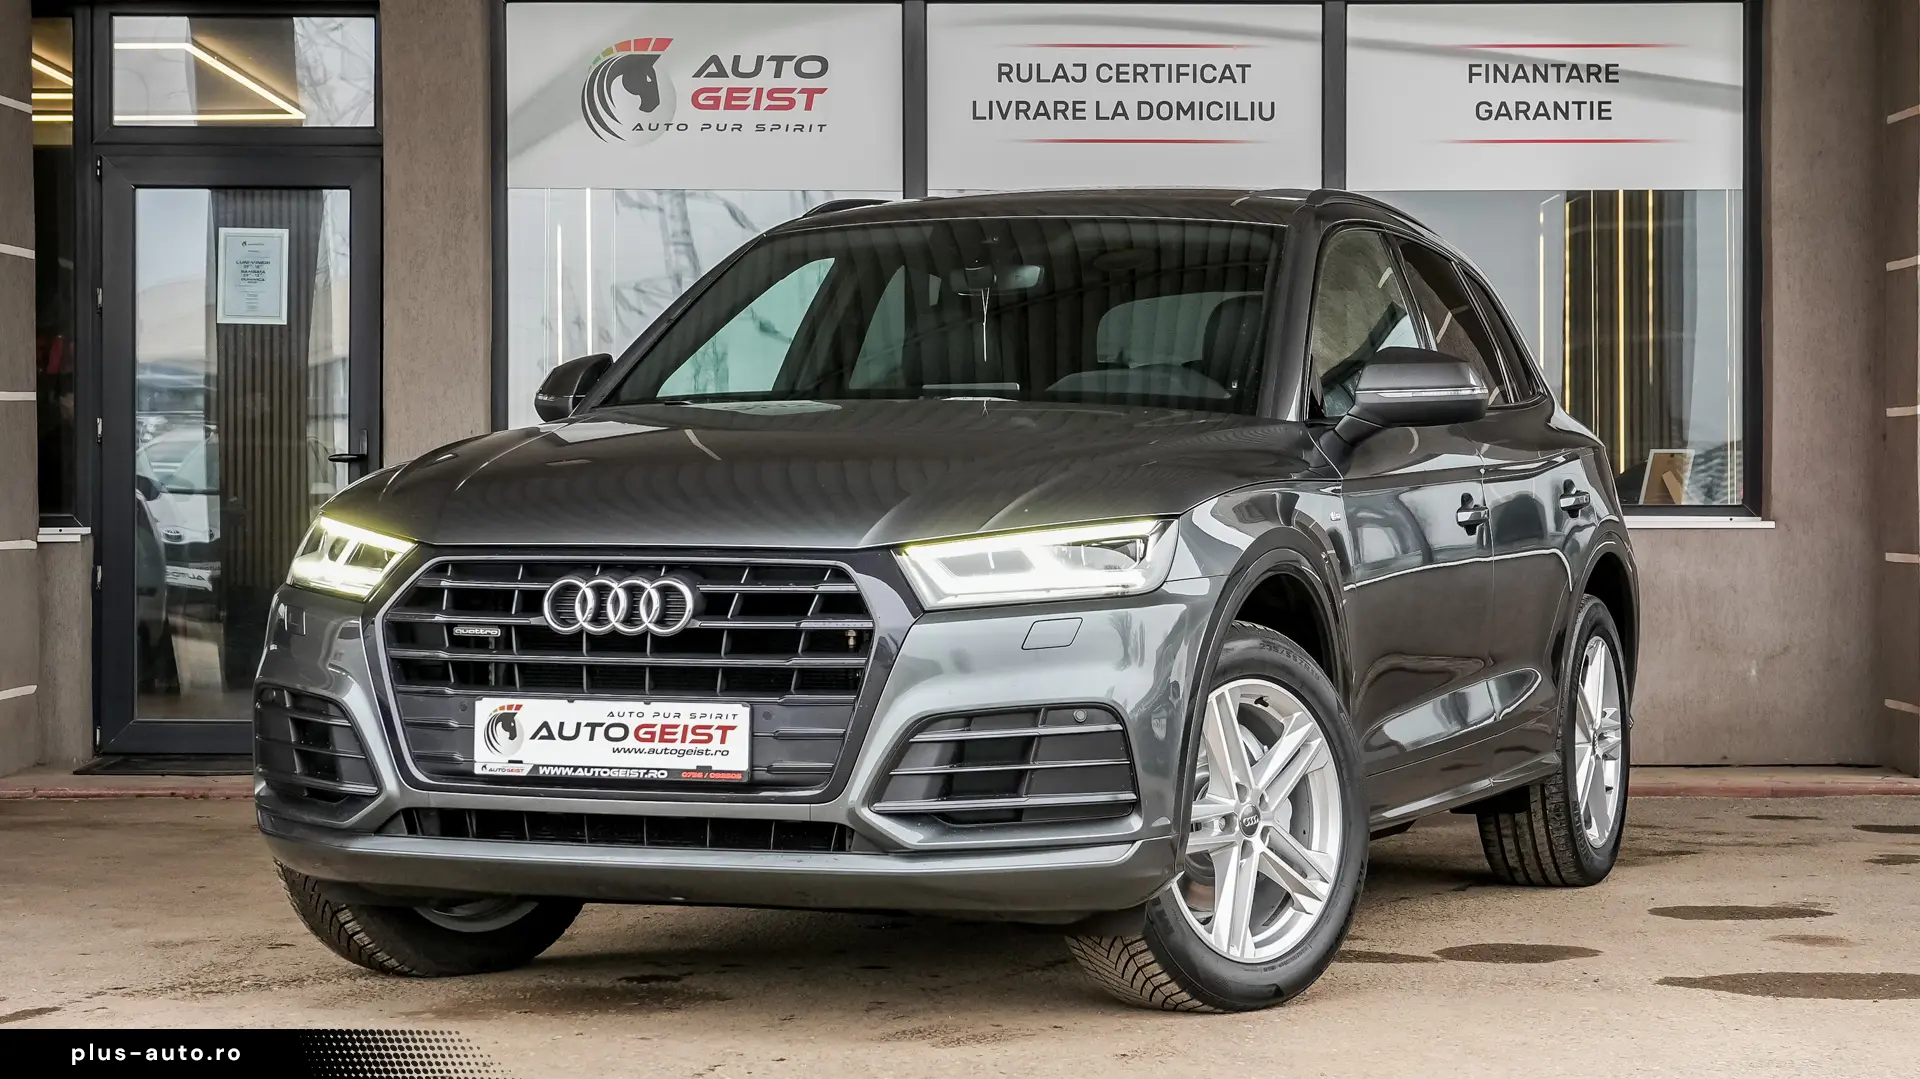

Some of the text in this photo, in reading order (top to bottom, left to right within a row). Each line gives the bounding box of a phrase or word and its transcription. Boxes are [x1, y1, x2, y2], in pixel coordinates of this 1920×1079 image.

[691, 54, 829, 80] AUTO
[997, 62, 1252, 84] RULAJ CERTIFICAT
[1468, 63, 1620, 84] FINANTARE
[690, 86, 829, 112] GEIST
[972, 100, 1276, 122] LIVRARE LA DOMICILIU
[1475, 100, 1613, 121] GARANTIE
[632, 122, 828, 133] AUTO PUR SPIRIT
[652, 711, 682, 719] PUR
[689, 712, 739, 720] SPIRIT
[612, 746, 730, 758] www.autogeist.ro
[538, 766, 669, 779] WWW.AUTOGEIST.RO
